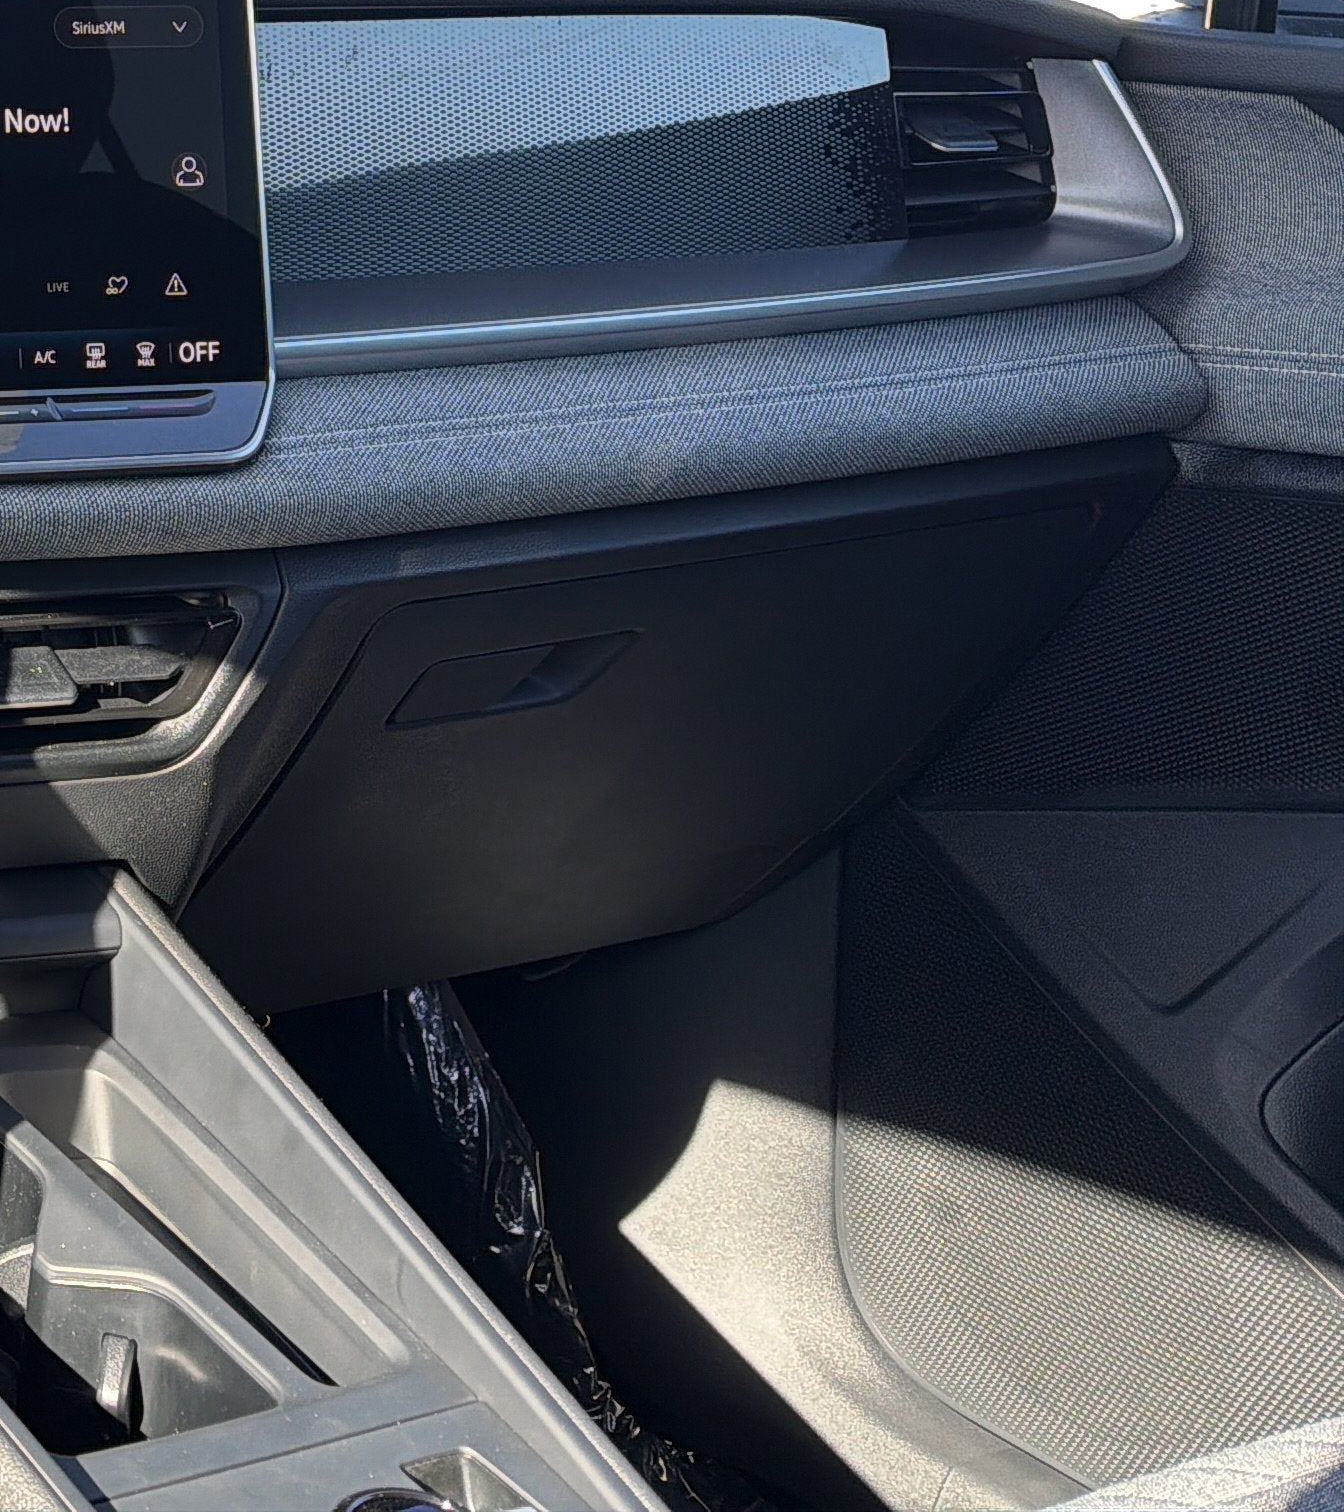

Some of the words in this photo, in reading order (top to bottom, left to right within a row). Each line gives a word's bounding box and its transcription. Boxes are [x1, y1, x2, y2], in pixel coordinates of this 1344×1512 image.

[72, 20, 126, 36] SiriusXM
[4, 107, 70, 134] Now!
[47, 281, 70, 293] LIVE
[34, 350, 57, 364] A/C
[178, 341, 221, 364] OFF
[86, 359, 107, 369] REAR
[137, 358, 156, 367] MAX
